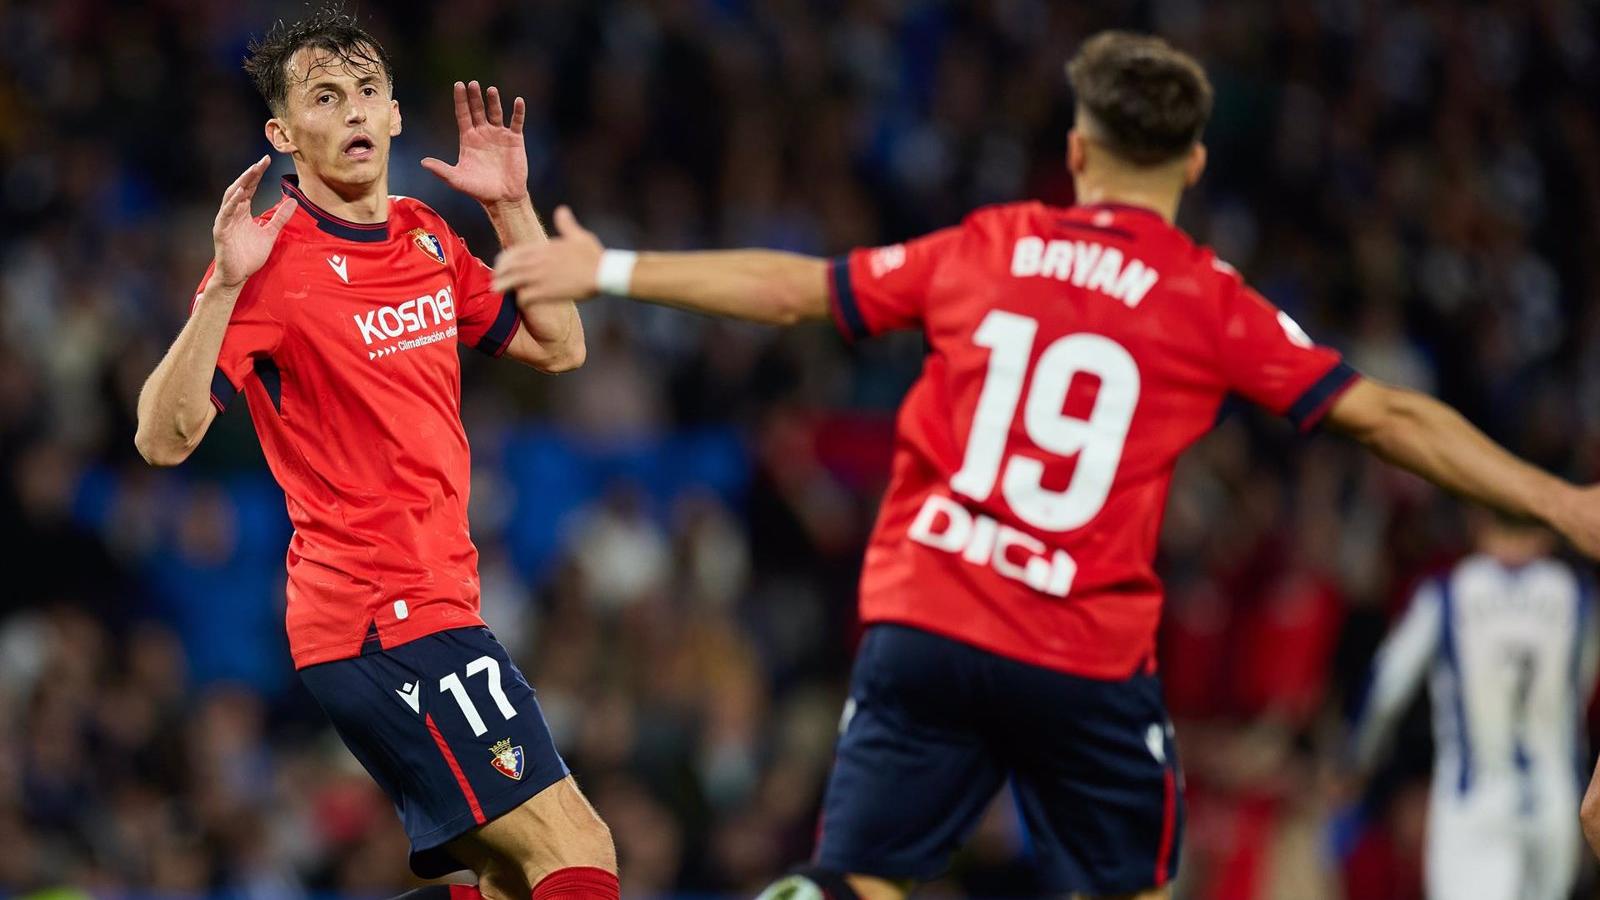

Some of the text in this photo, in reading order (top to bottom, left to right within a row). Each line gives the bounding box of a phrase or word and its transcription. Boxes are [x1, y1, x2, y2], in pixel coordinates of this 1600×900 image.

[1011, 236, 1158, 308] BRYAN
[397, 330, 446, 351] Climatización
[951, 309, 1141, 532] 19
[907, 494, 1078, 598] DIGI
[439, 655, 518, 737] 17
